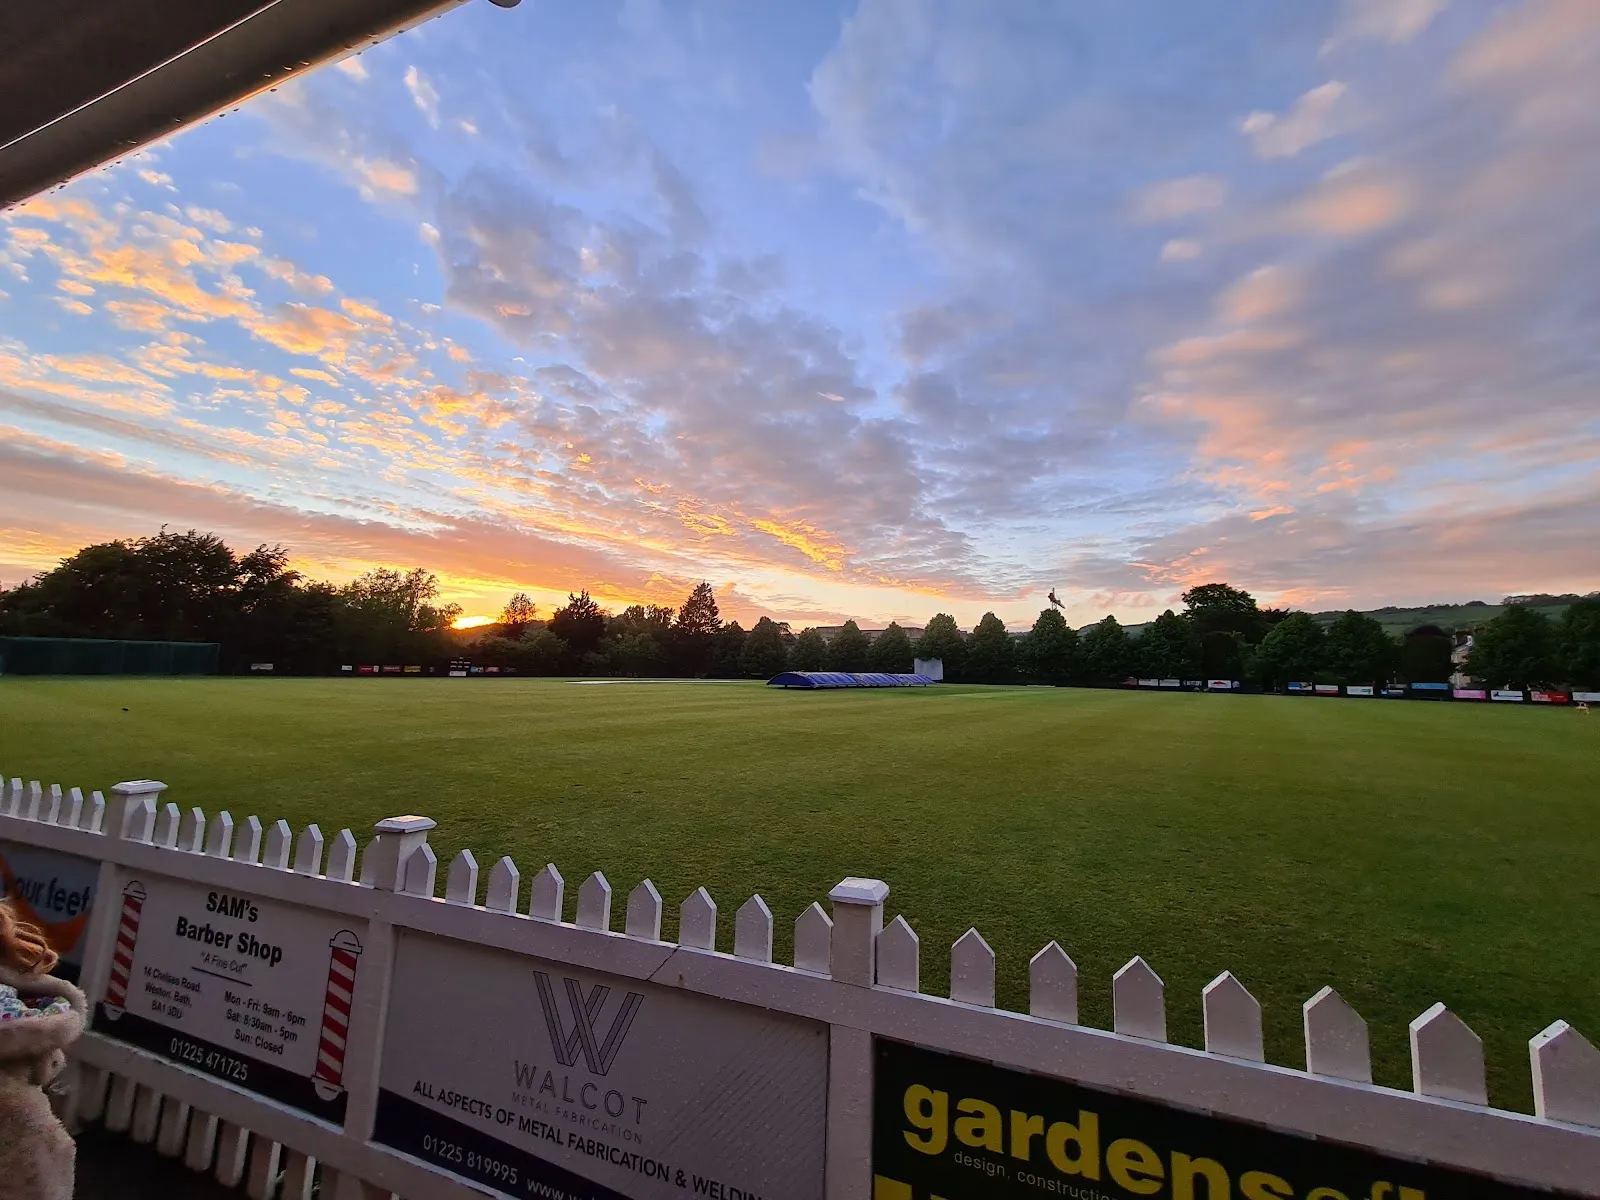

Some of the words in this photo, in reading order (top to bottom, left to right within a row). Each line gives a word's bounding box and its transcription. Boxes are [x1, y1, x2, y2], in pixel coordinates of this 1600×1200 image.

[46, 877, 90, 916] feet
[206, 891, 259, 922] SAM's
[176, 916, 233, 949] Barber
[237, 932, 282, 967] Shop
[144, 966, 152, 976] 14
[211, 955, 228, 969] Fine
[152, 1000, 166, 1013] BA1
[224, 991, 241, 1005] Mon
[247, 998, 261, 1012] Fri:
[262, 1003, 280, 1019] 9am
[287, 1011, 306, 1026] 6pm
[226, 1008, 241, 1022] Sat:
[243, 1014, 273, 1034] 8:30am
[279, 1027, 298, 1042] 5pm
[234, 1028, 253, 1044] Sun:
[255, 1036, 284, 1055] Closed
[170, 1037, 204, 1064] 01225
[206, 1051, 249, 1081] 471725
[514, 1060, 648, 1125] WALCOT
[413, 1079, 435, 1100] ALL
[437, 1088, 493, 1119] ASPECTS
[496, 1108, 515, 1127] OF
[518, 1115, 564, 1145] METAL
[567, 1132, 670, 1183] FABRICATION
[675, 1169, 687, 1188] &
[511, 1092, 549, 1114] METAL
[555, 1106, 643, 1145] FABRICATION
[423, 1134, 463, 1162] 01225
[466, 1151, 519, 1186] 819995
[954, 1151, 1011, 1180] design,
